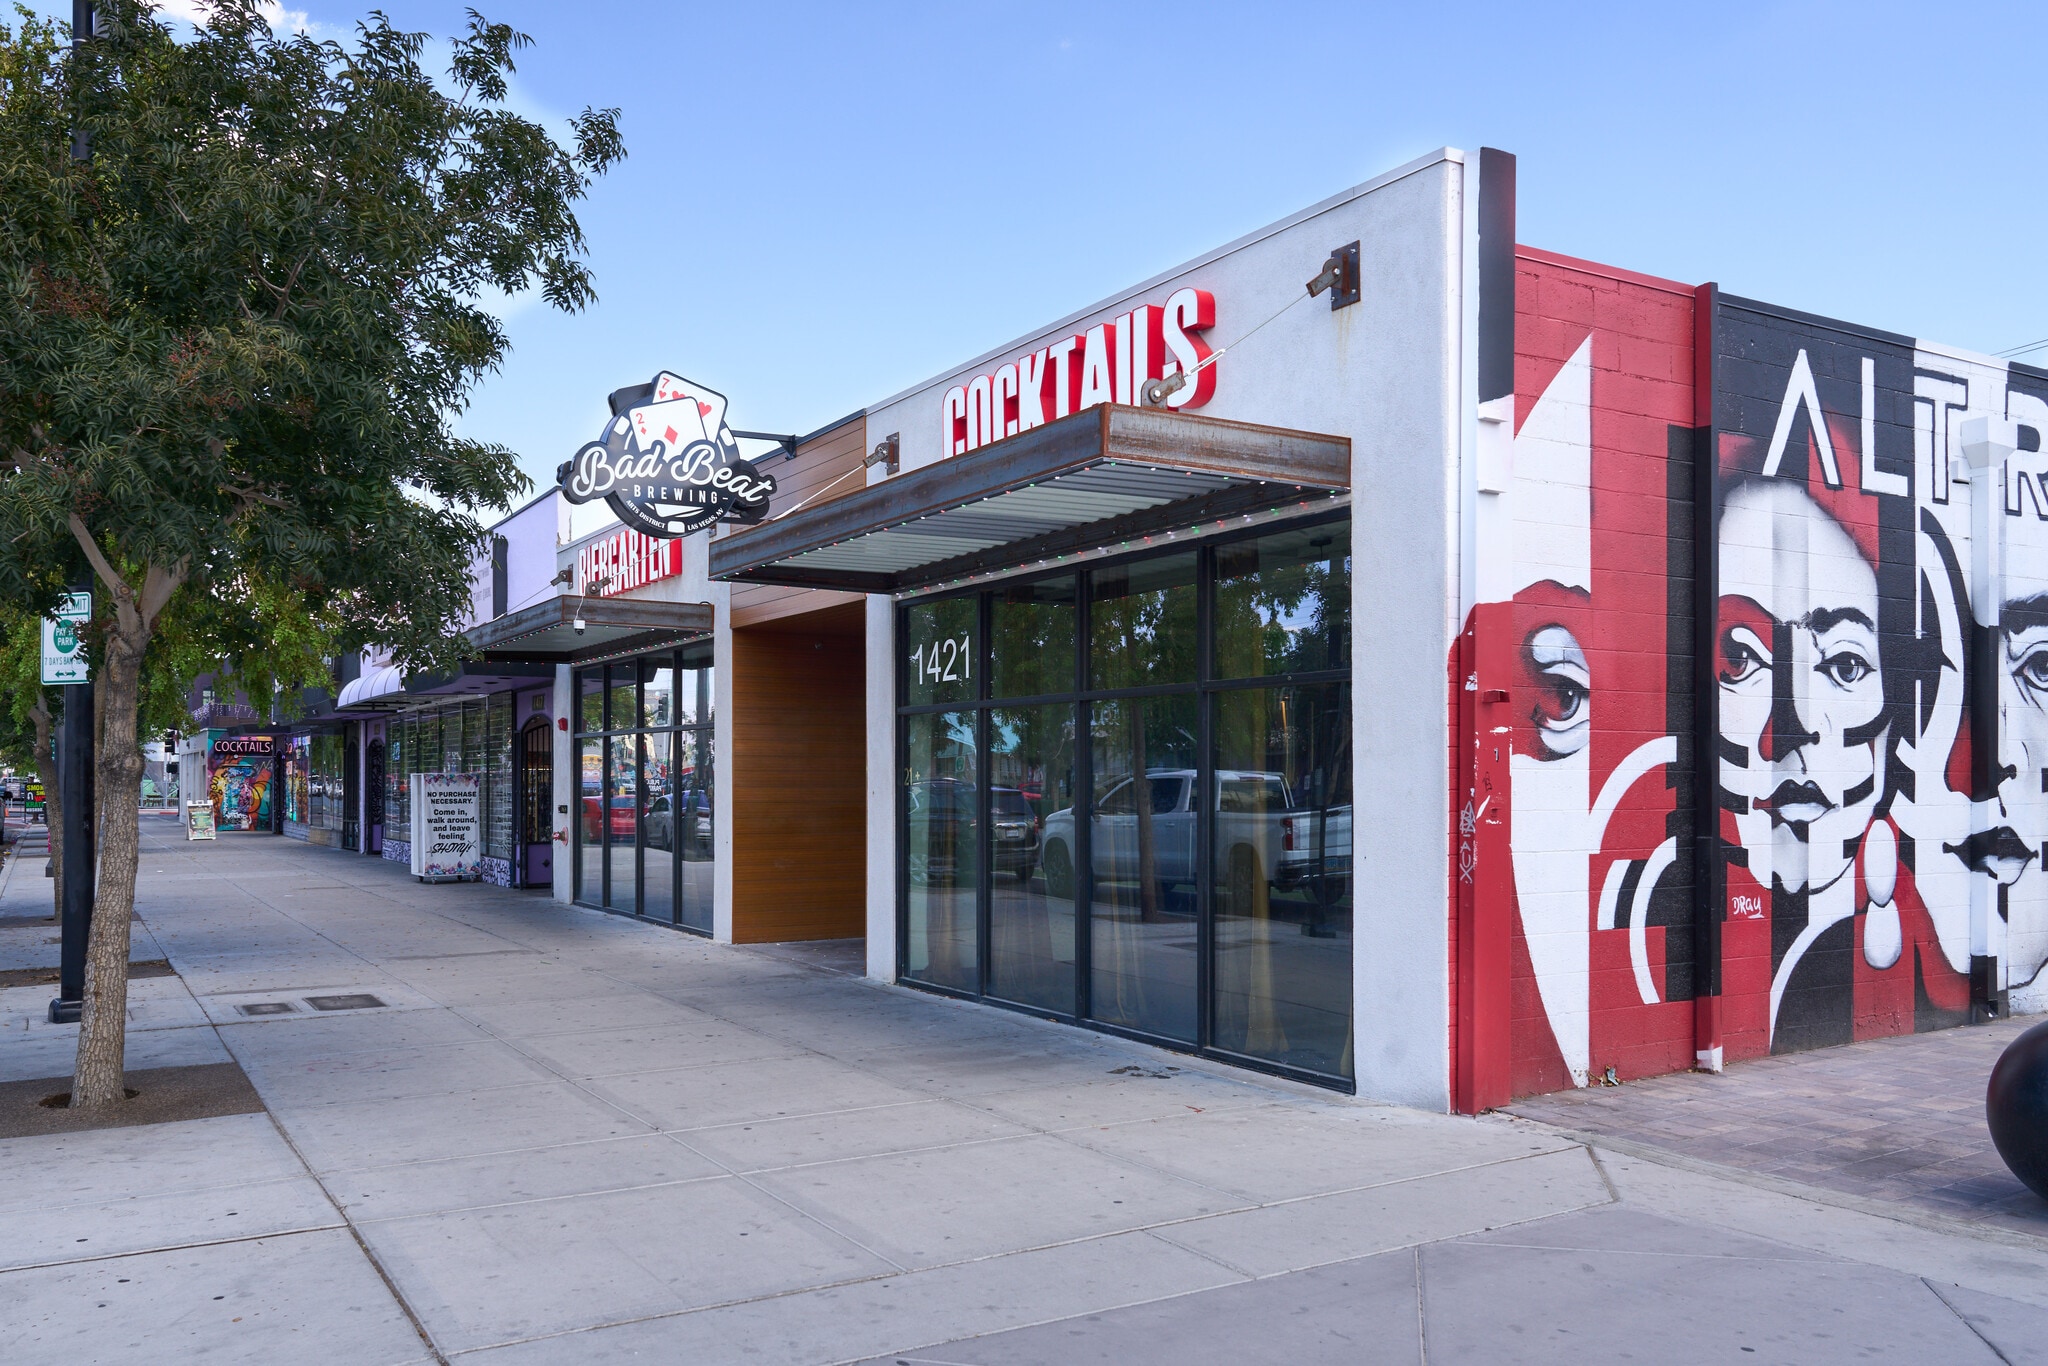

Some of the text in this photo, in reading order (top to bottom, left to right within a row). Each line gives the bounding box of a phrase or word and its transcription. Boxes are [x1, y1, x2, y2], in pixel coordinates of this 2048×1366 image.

[942, 287, 1216, 460] COCKTAILS
[661, 377, 671, 389] 7
[635, 412, 645, 425] 2
[572, 444, 773, 503] Bad Beat
[633, 484, 718, 504] BREWING
[626, 499, 666, 529] ARTS DISTRICT
[687, 522, 699, 531] LAS
[716, 507, 724, 518] NV
[578, 527, 682, 597] BIERGARTEN
[55, 627, 66, 636] PAY
[57, 637, 74, 646] PARK
[48, 657, 63, 666] DAYS
[914, 635, 970, 685] 1421
[214, 741, 271, 753] COCKTAILS
[438, 833, 465, 841] feeling
